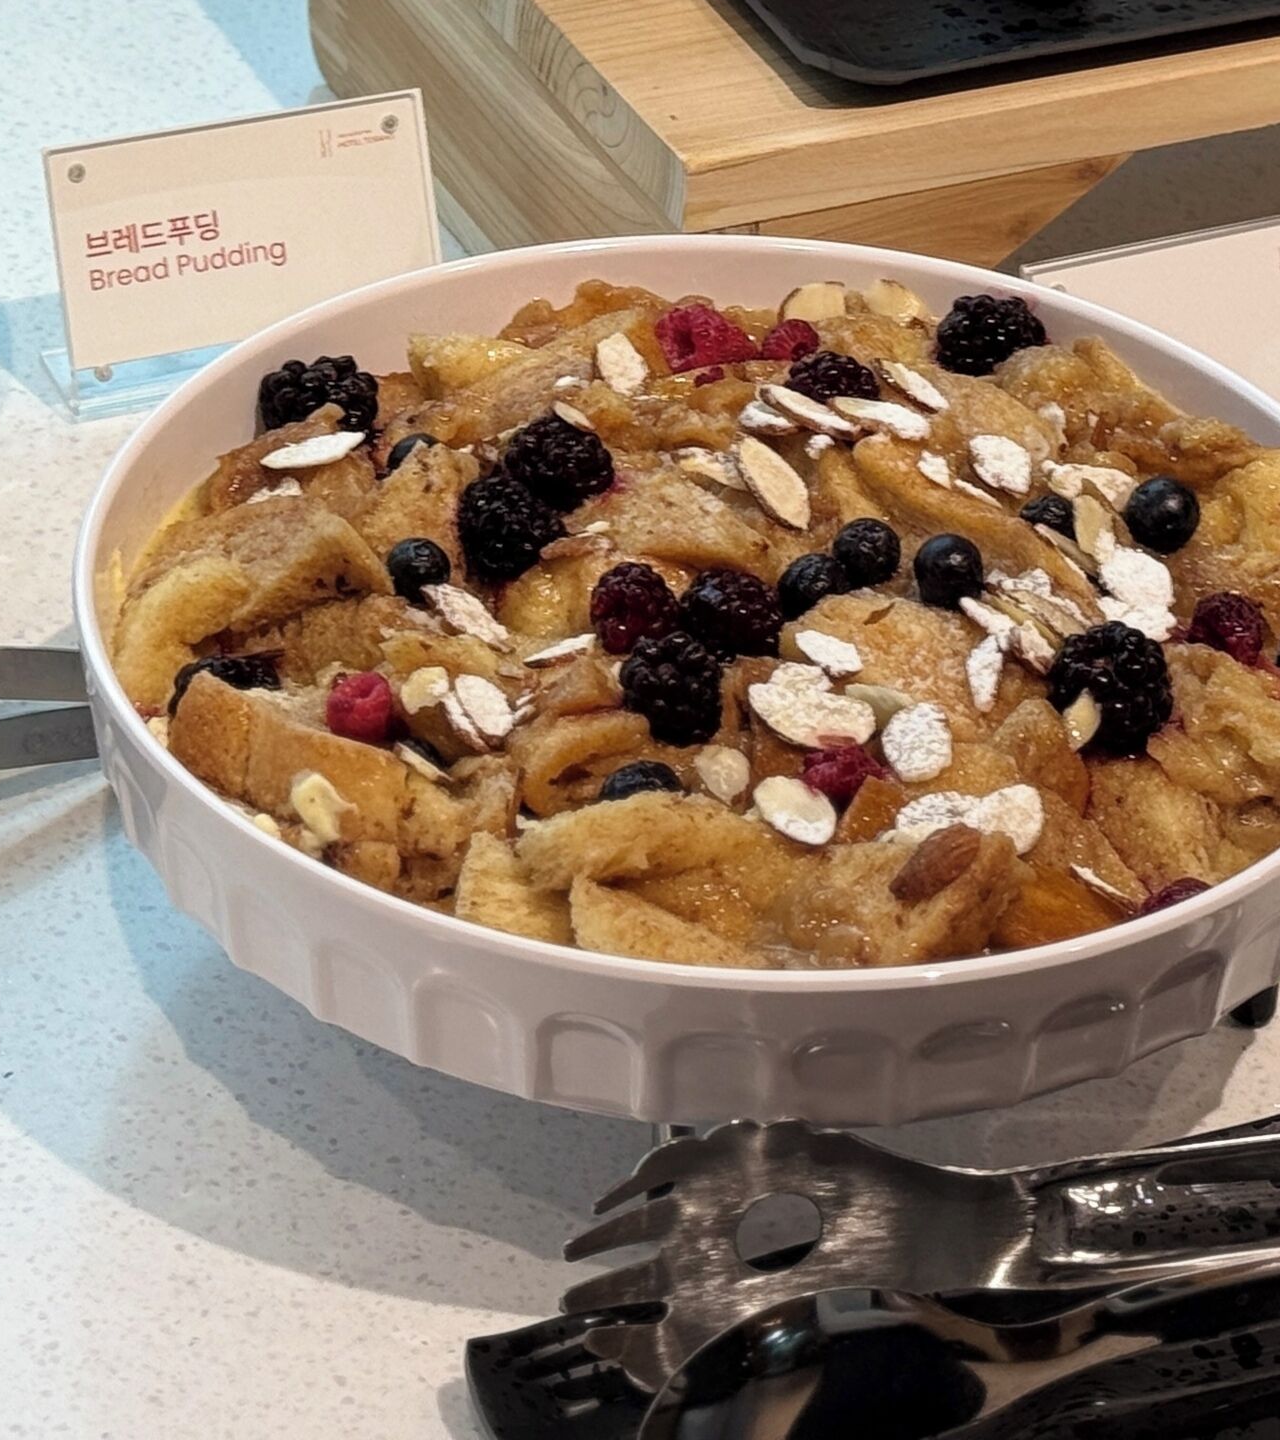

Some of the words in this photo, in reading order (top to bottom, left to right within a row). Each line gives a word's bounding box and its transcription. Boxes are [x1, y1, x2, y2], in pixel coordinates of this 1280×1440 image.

[85, 209, 220, 258] 브레드푸딩
[89, 257, 170, 291] Bread
[176, 241, 287, 276] Pudding
